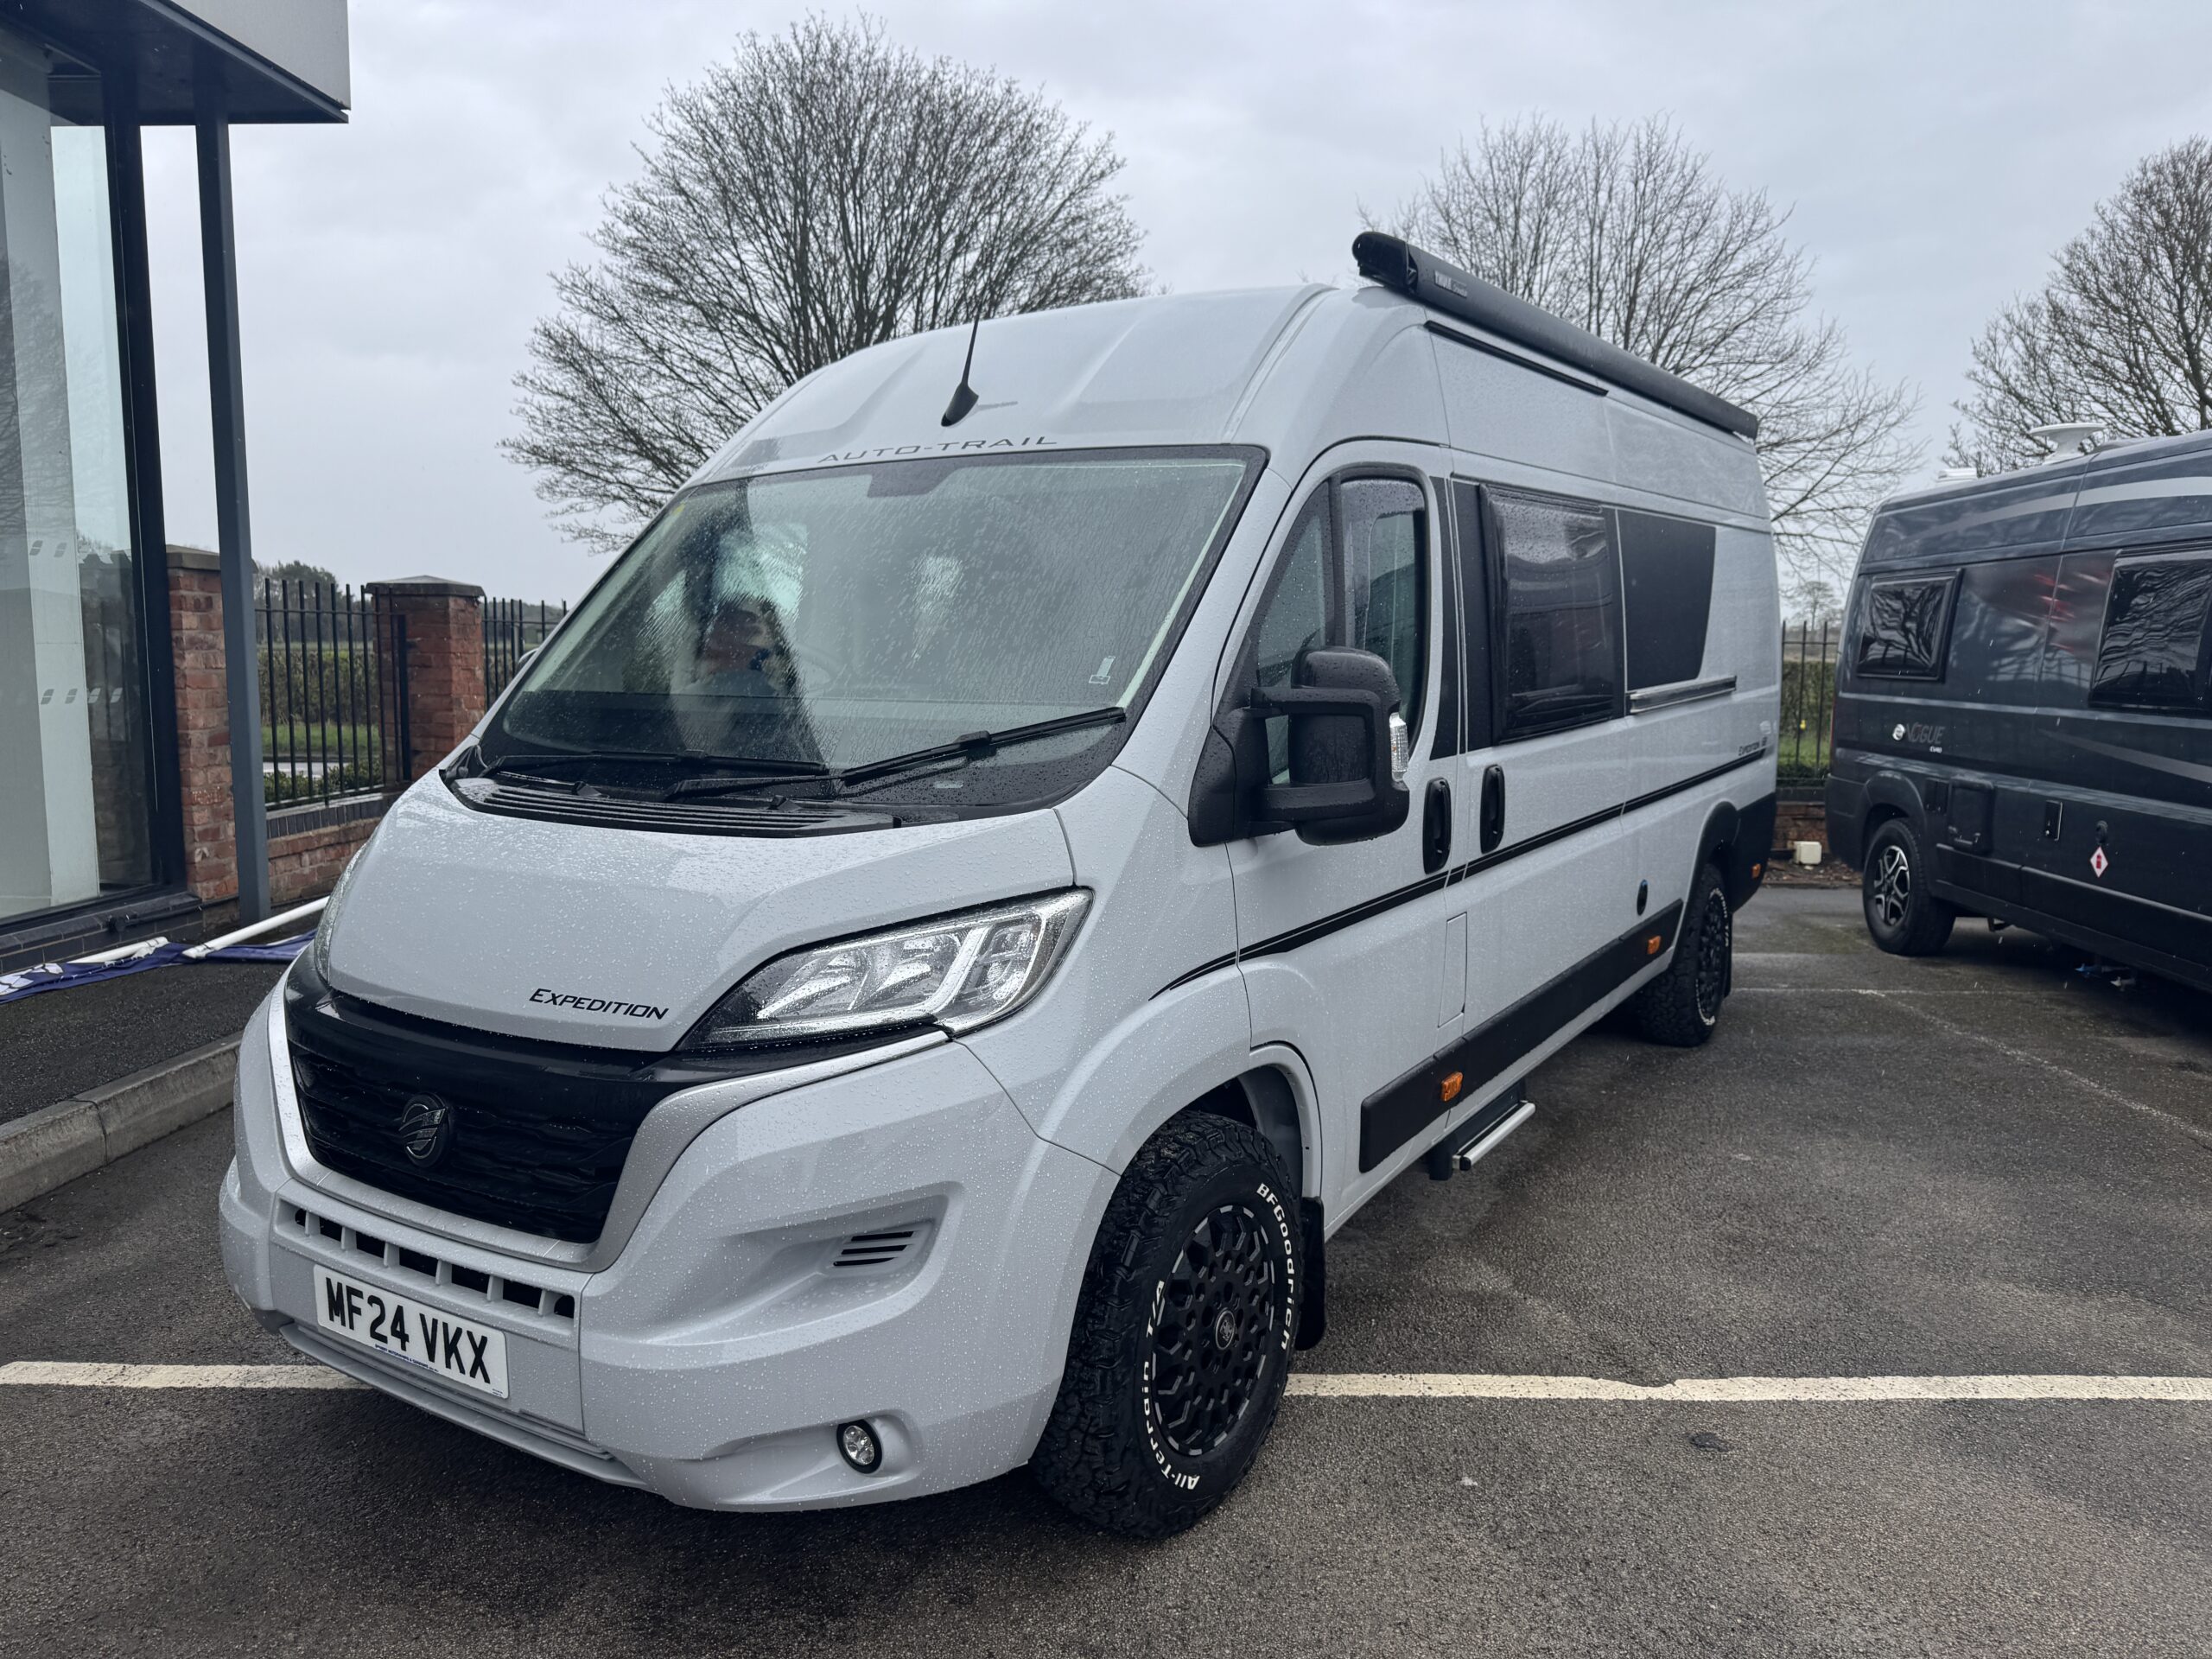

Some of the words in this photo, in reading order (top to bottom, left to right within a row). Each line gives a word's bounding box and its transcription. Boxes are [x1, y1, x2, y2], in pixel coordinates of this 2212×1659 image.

[817, 435, 1057, 463] AUTO-TRAIL
[1256, 1182, 1294, 1351] BFGoodrich
[325, 1276, 410, 1352] MF24
[419, 1313, 491, 1385] VKX
[1146, 1280, 1166, 1338] T/A
